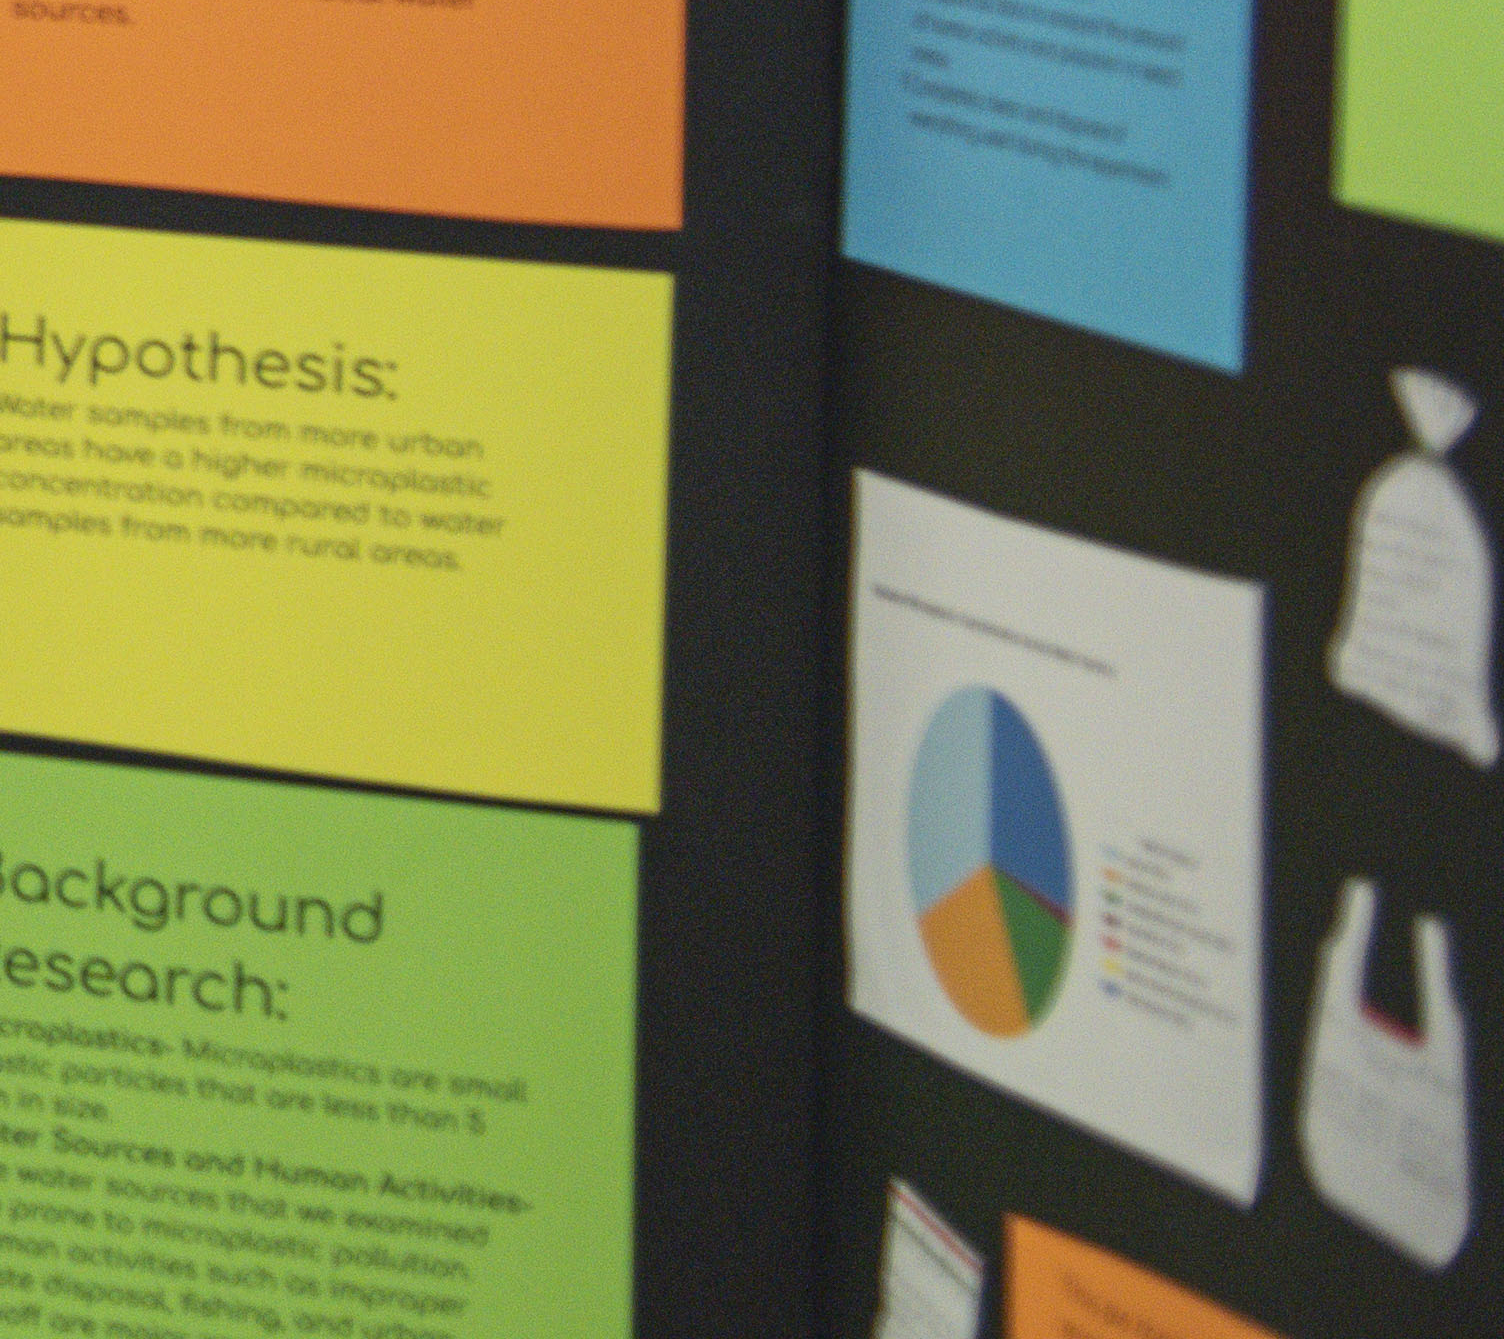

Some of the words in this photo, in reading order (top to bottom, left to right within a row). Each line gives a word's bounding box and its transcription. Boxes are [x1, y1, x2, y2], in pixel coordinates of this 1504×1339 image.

[88, 406, 210, 435] samples
[219, 414, 290, 439] from
[300, 425, 379, 450] more
[387, 432, 485, 460] urban
[182, 1039, 382, 1086] Microplastics
[388, 1068, 441, 1093] are
[448, 1075, 528, 1103] small
